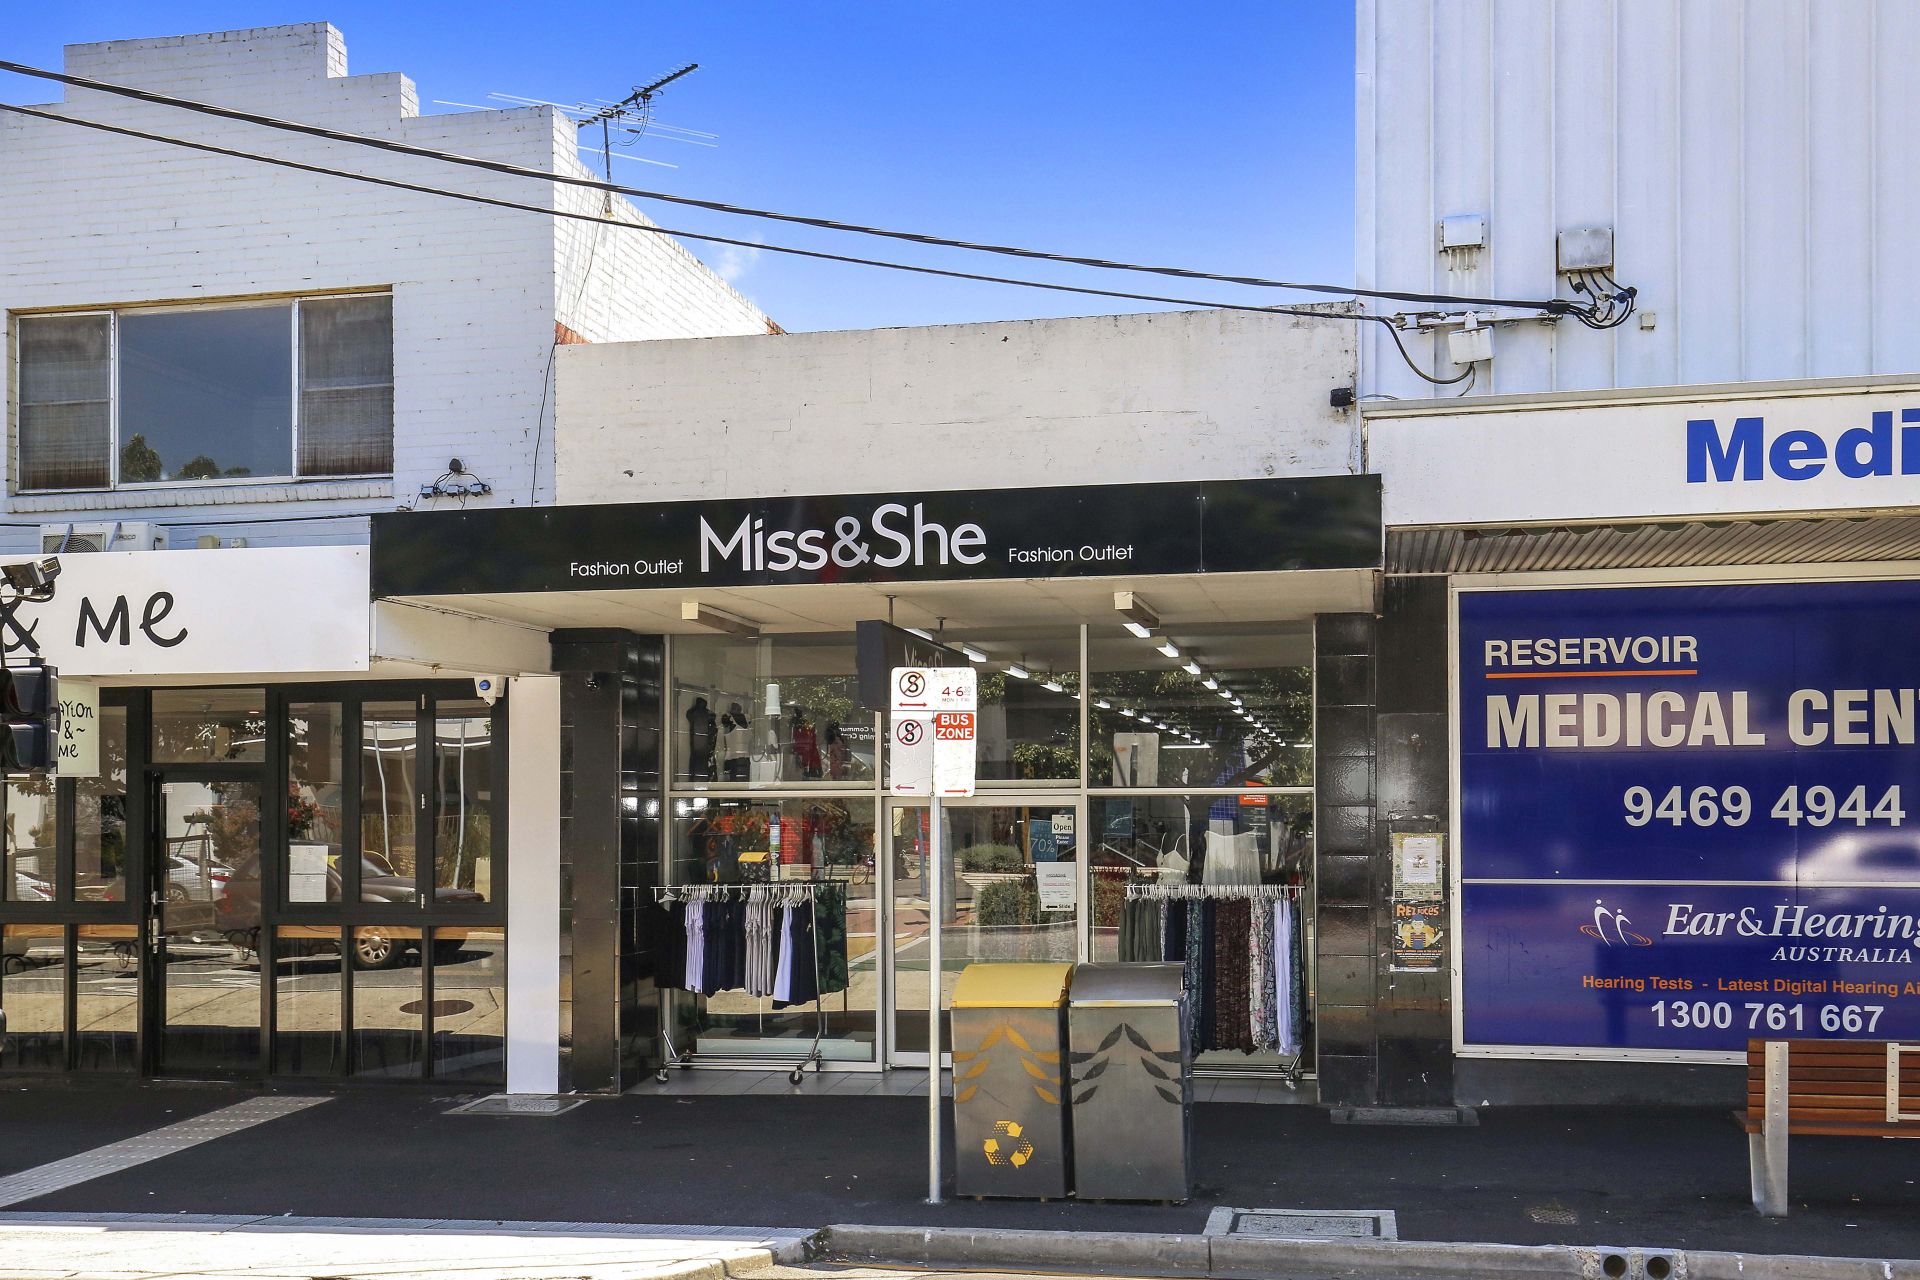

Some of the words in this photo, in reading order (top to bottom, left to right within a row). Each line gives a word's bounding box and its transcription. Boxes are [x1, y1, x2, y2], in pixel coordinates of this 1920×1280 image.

[1687, 408, 1920, 483] Medi
[700, 502, 987, 573] Miss&She
[1009, 546, 1072, 563] Fashion
[1079, 544, 1134, 561] Outlet
[570, 561, 630, 577] Fashion
[634, 559, 684, 576] Outlet
[1484, 635, 1698, 667] RESERVOIR
[941, 714, 969, 726] BUS
[1486, 690, 1766, 748] MEDICAL
[1788, 688, 1920, 746] CEN
[64, 720, 74, 740] &
[936, 727, 973, 739] ZONE
[1623, 785, 1752, 827] 9469
[1770, 784, 1906, 827] 4944
[1053, 823, 1072, 832] Open
[1770, 946, 1912, 964] AUSTRALIA
[1583, 975, 1645, 992] Hearing
[1650, 976, 1693, 990] Tests
[1718, 978, 1769, 992] Latest
[1774, 978, 1827, 996] Digital
[1832, 980, 1899, 998] Hearing
[1651, 1000, 1732, 1029] 1300
[1744, 1002, 1803, 1031] 761
[1820, 1004, 1884, 1033] 667
